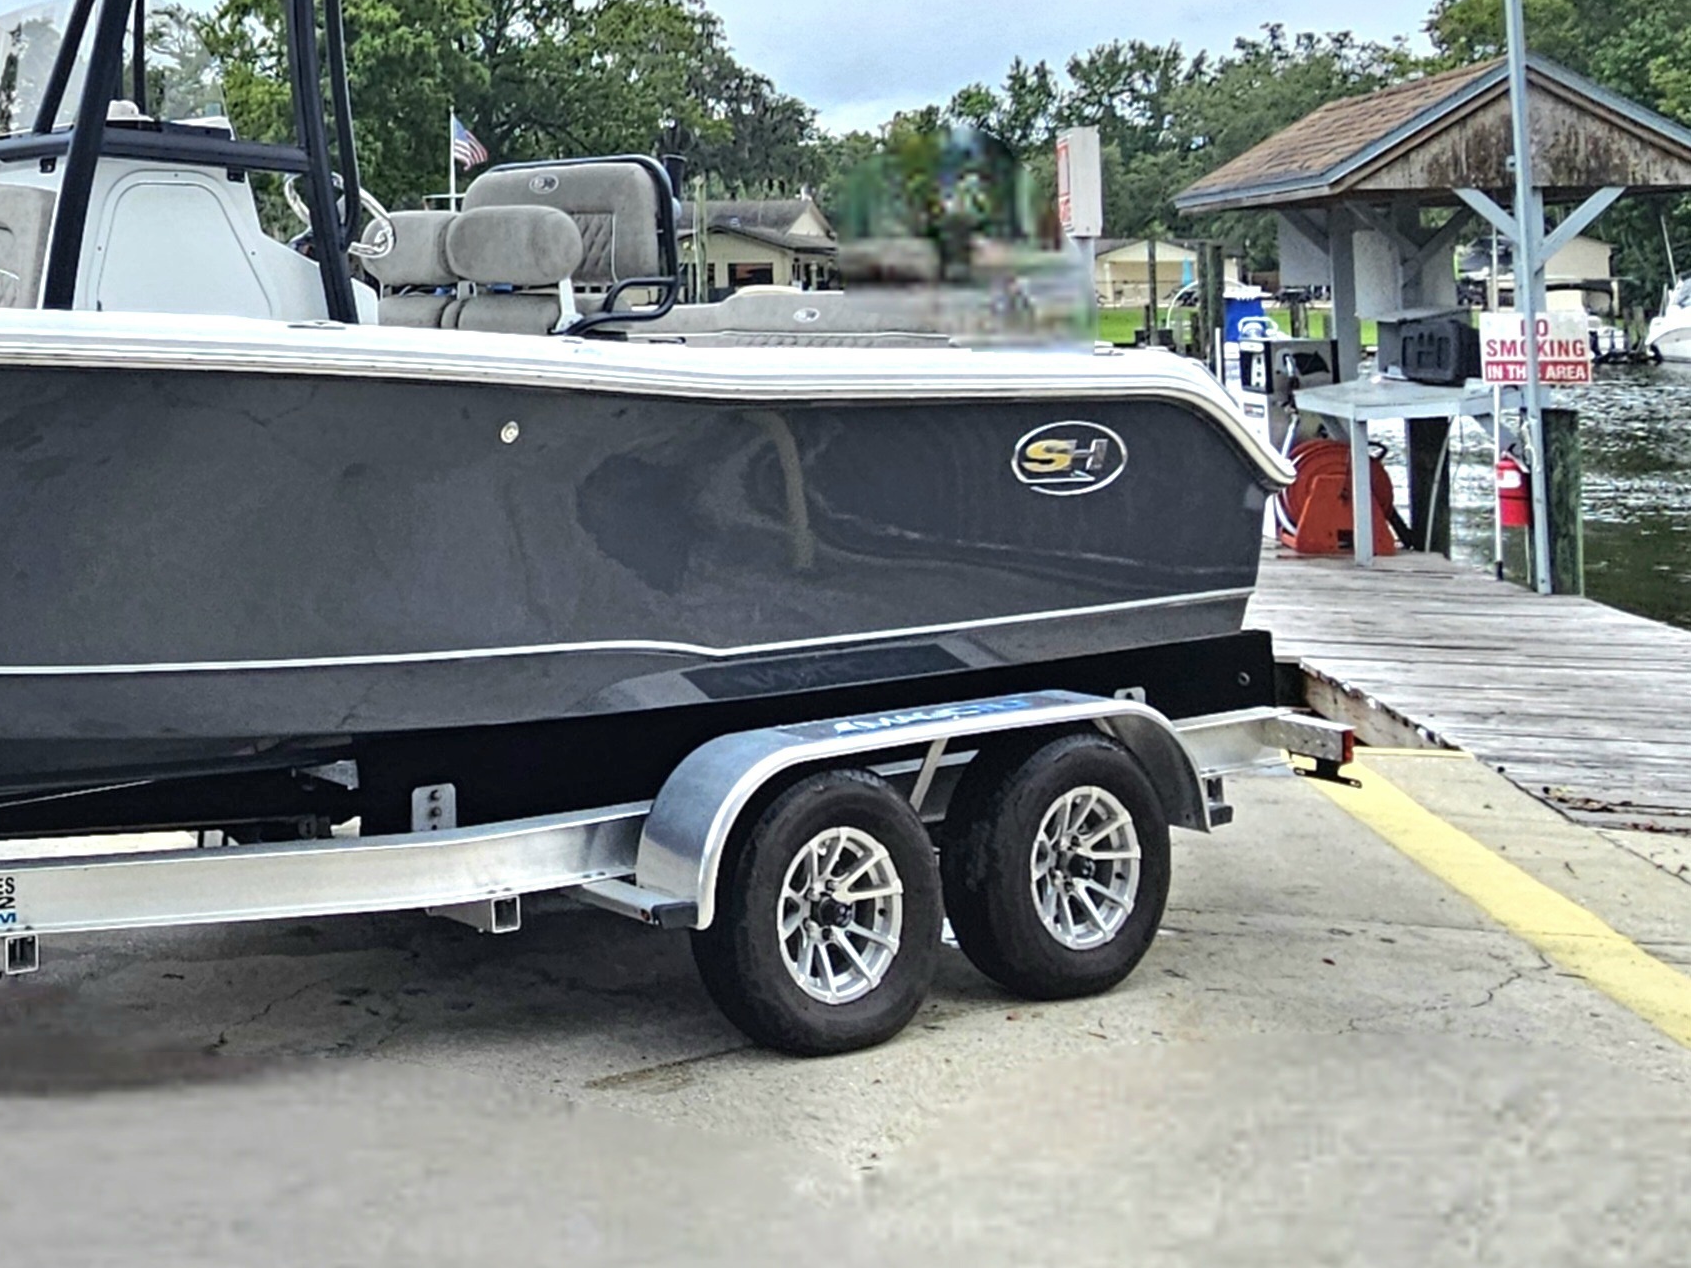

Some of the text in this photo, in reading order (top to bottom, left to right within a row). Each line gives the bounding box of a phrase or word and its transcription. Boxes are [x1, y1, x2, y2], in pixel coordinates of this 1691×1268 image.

[1487, 364, 1586, 380] IN TH AREA
